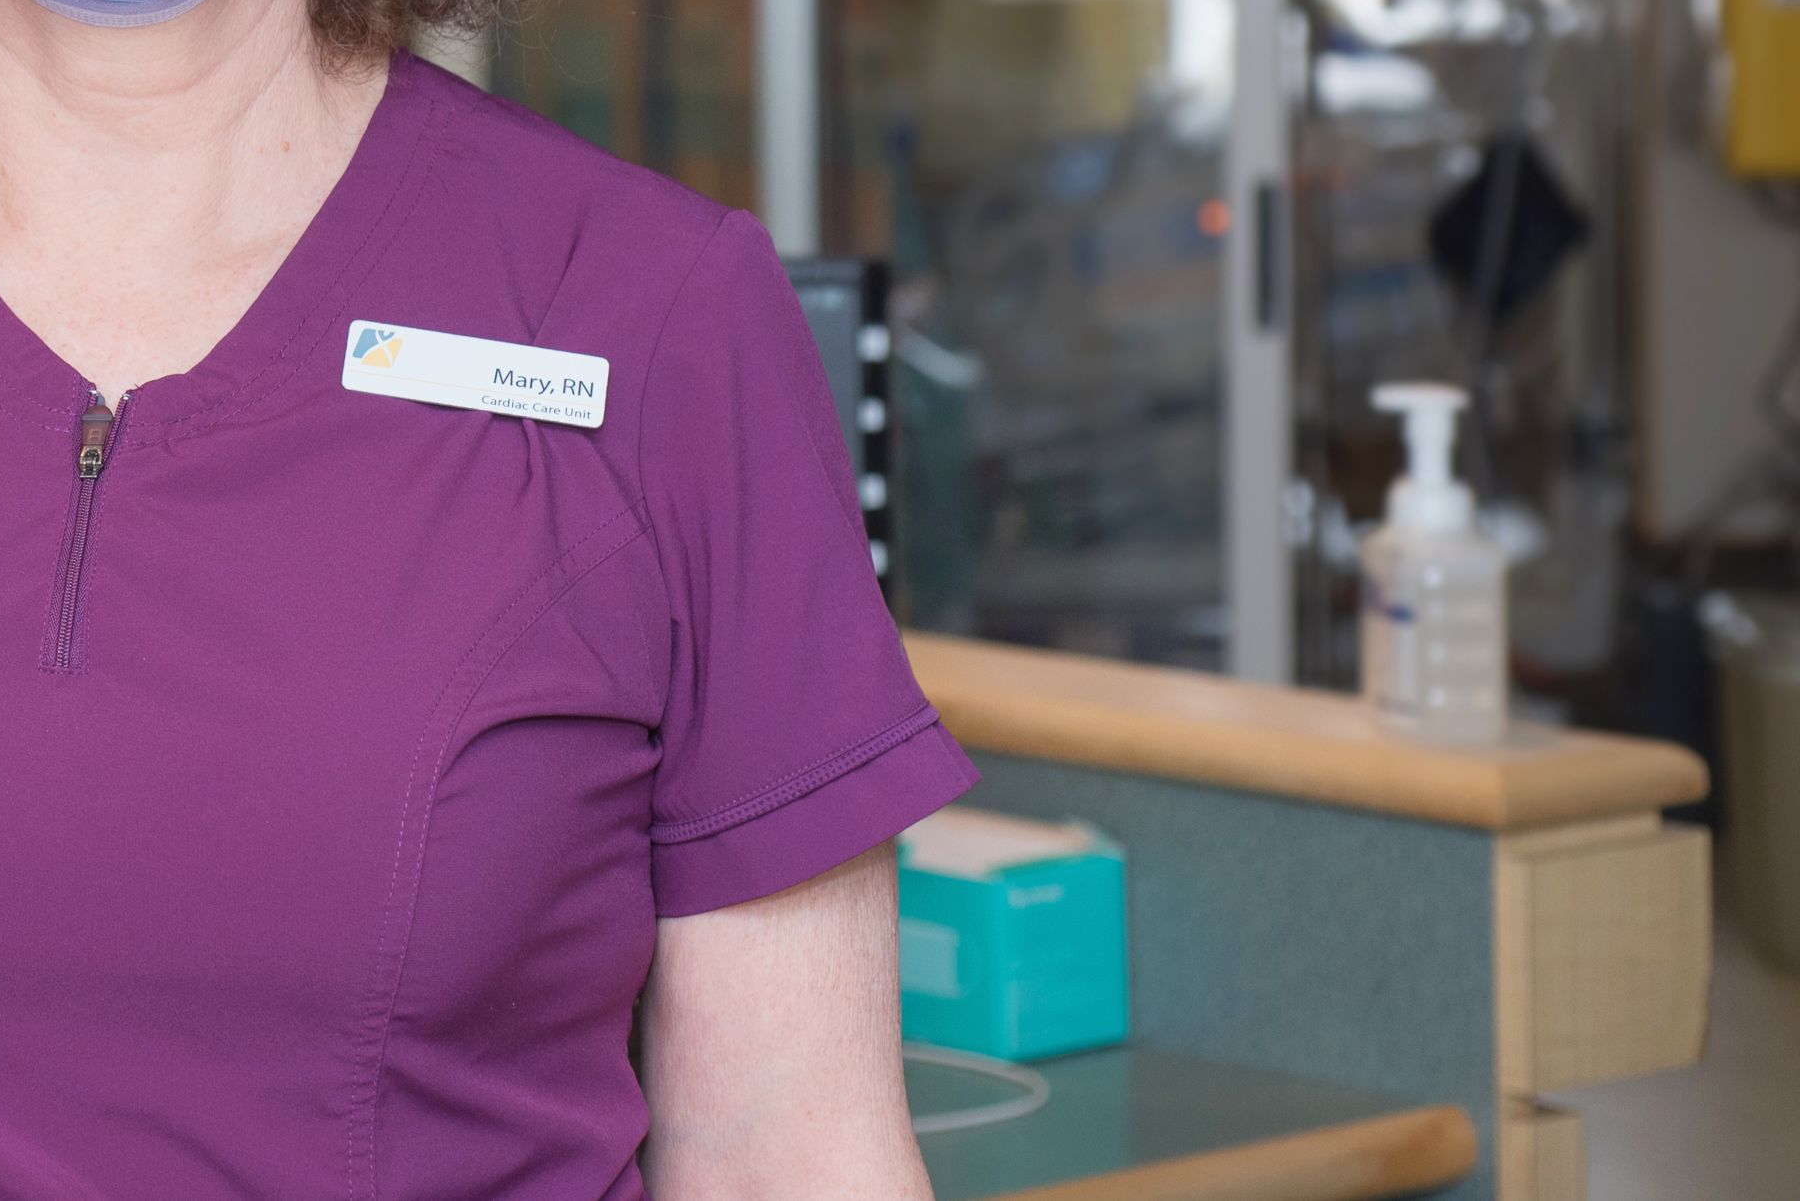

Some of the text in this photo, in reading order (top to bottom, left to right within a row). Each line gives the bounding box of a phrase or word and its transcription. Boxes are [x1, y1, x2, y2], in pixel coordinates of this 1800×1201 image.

[493, 368, 594, 398] Mary, RN
[481, 395, 591, 420] Cardiac Care Unit
